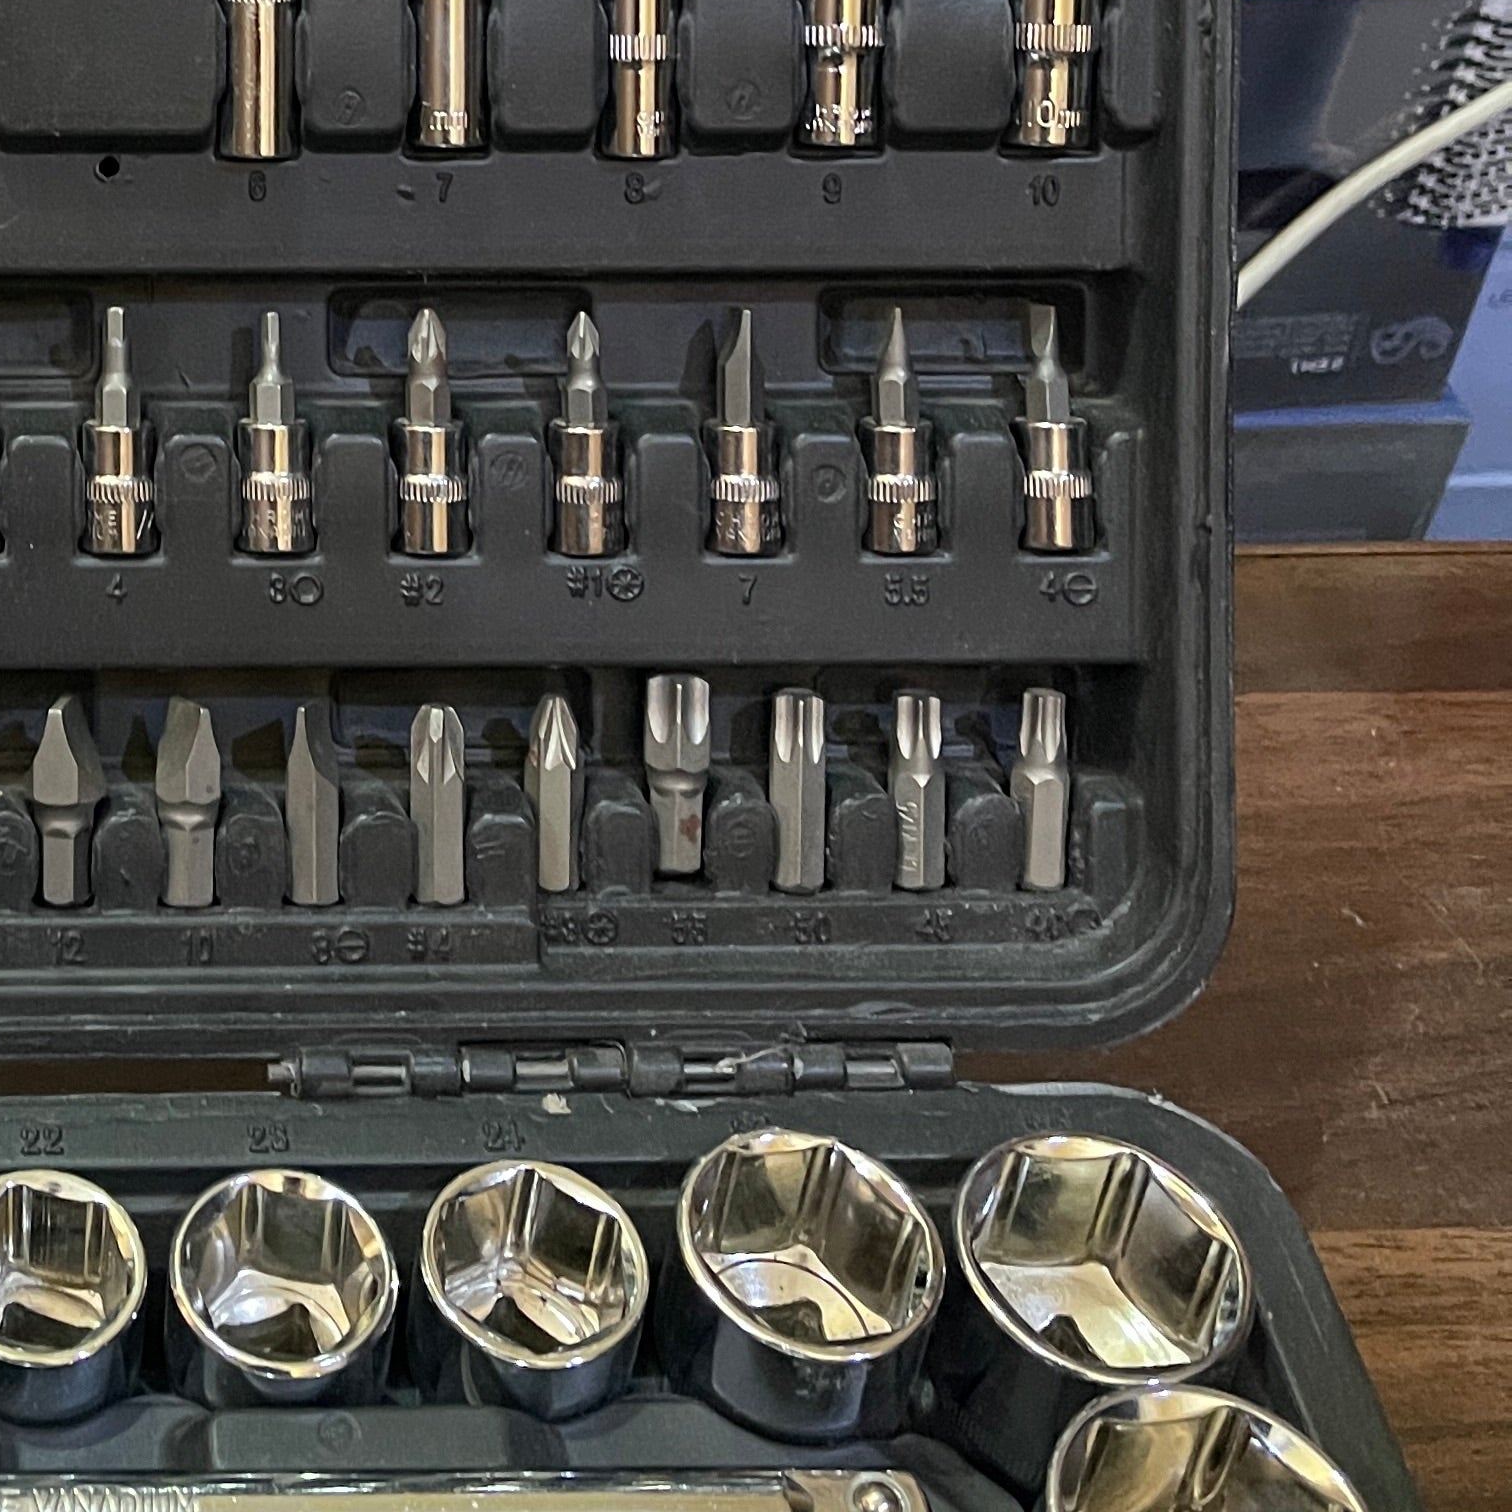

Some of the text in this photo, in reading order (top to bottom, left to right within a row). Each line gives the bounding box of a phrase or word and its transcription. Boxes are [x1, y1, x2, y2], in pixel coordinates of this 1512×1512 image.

[247, 170, 268, 203] 6
[435, 172, 454, 204] 7
[623, 172, 645, 205] 8
[821, 172, 843, 205] 9
[1029, 174, 1061, 207] 10
[105, 573, 128, 605] 4
[399, 572, 445, 607] #2
[566, 567, 603, 600] #1
[736, 573, 759, 606] 7
[884, 573, 930, 606] 5.5
[20, 1124, 65, 1157] 22
[247, 1120, 291, 1155] 23
[482, 1119, 527, 1154] 24
